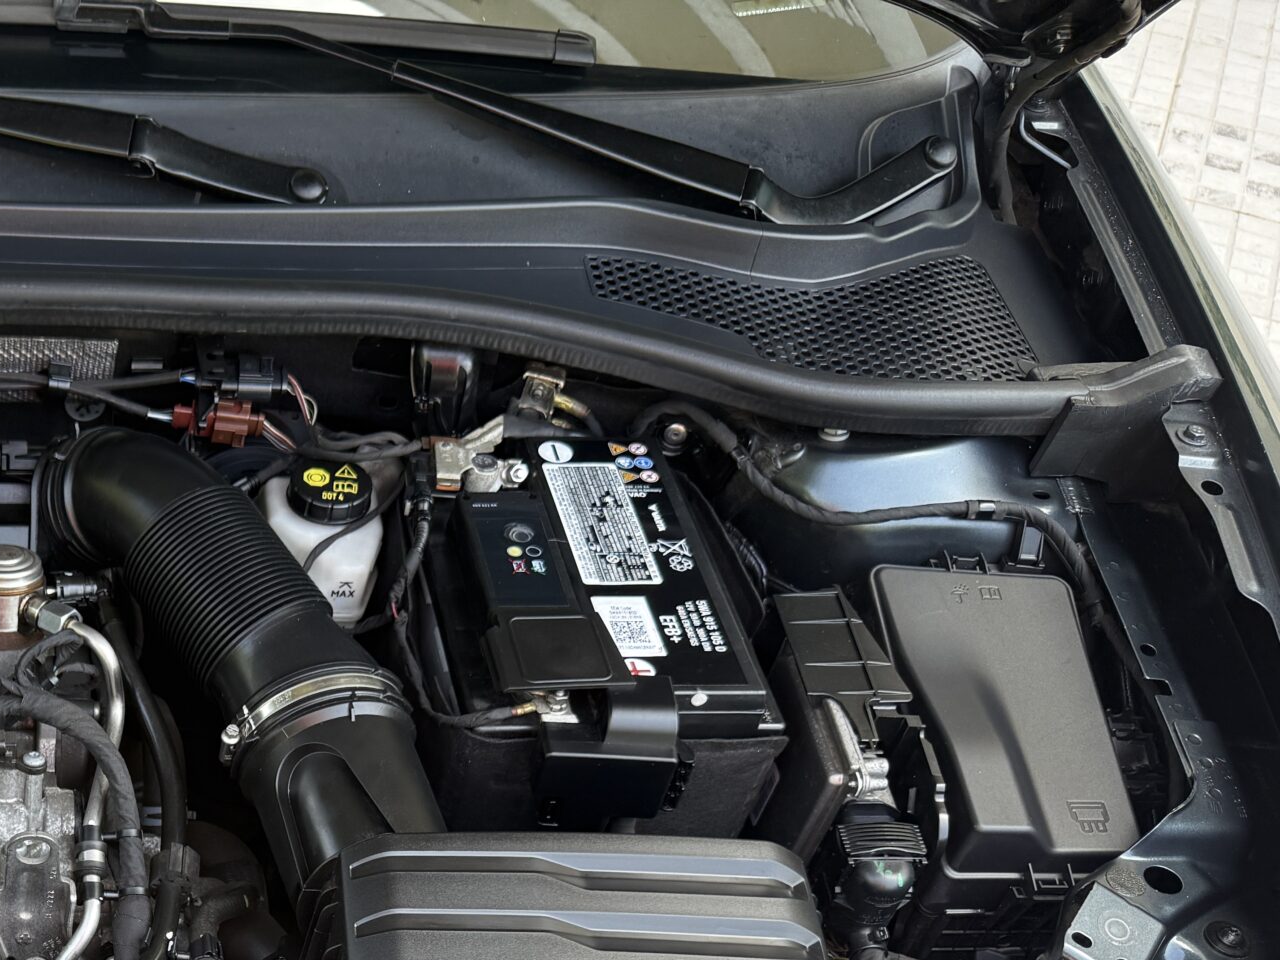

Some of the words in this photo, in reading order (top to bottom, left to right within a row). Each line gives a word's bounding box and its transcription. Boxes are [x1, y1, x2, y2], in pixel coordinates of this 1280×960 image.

[322, 491, 336, 501] DOT
[338, 493, 344, 501] 4
[331, 590, 355, 598] MAX
[659, 615, 683, 643] EFB+
[703, 616, 719, 630] 915
